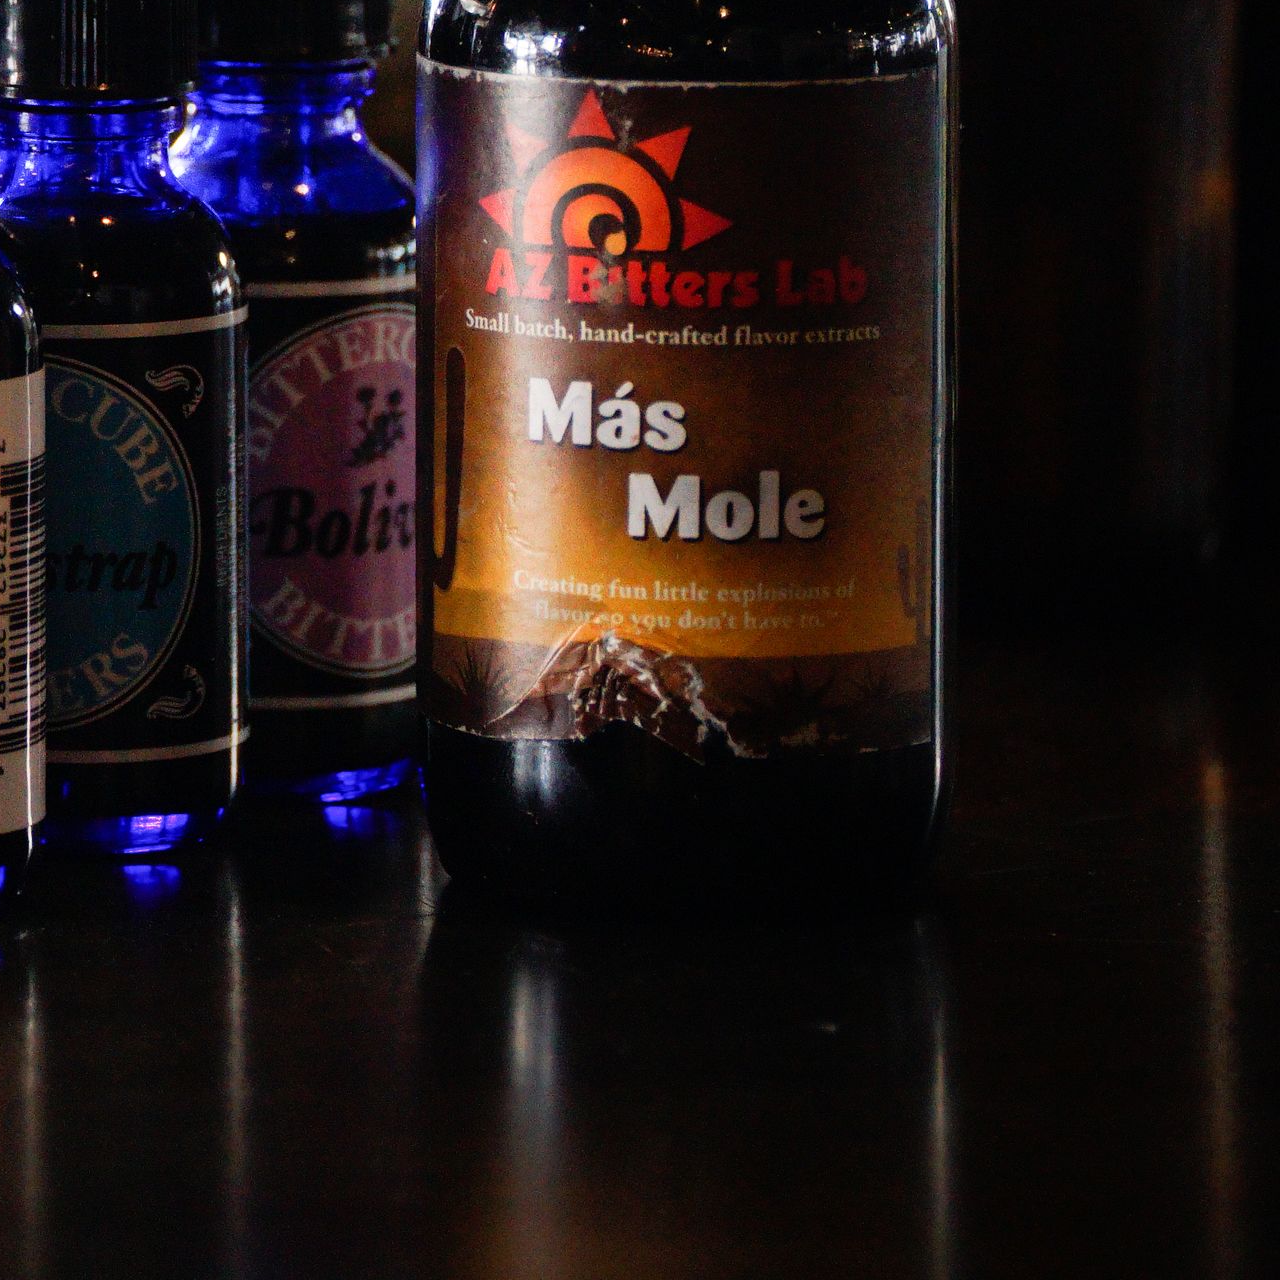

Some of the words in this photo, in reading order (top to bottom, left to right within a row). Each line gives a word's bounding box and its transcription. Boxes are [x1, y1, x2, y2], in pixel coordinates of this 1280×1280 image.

[485, 247, 553, 301] AZ
[567, 258, 757, 309] Bitters
[777, 255, 870, 306] Lab
[465, 308, 511, 334] Small
[513, 314, 574, 343] batch,
[580, 322, 728, 347] hand-crafted
[734, 325, 797, 346] flavor
[804, 323, 881, 344] extracts
[527, 376, 689, 453] Más
[626, 469, 828, 542] Mole
[512, 567, 603, 602] Creating
[608, 578, 648, 601] fun
[654, 578, 709, 602] little
[630, 610, 672, 634] you
